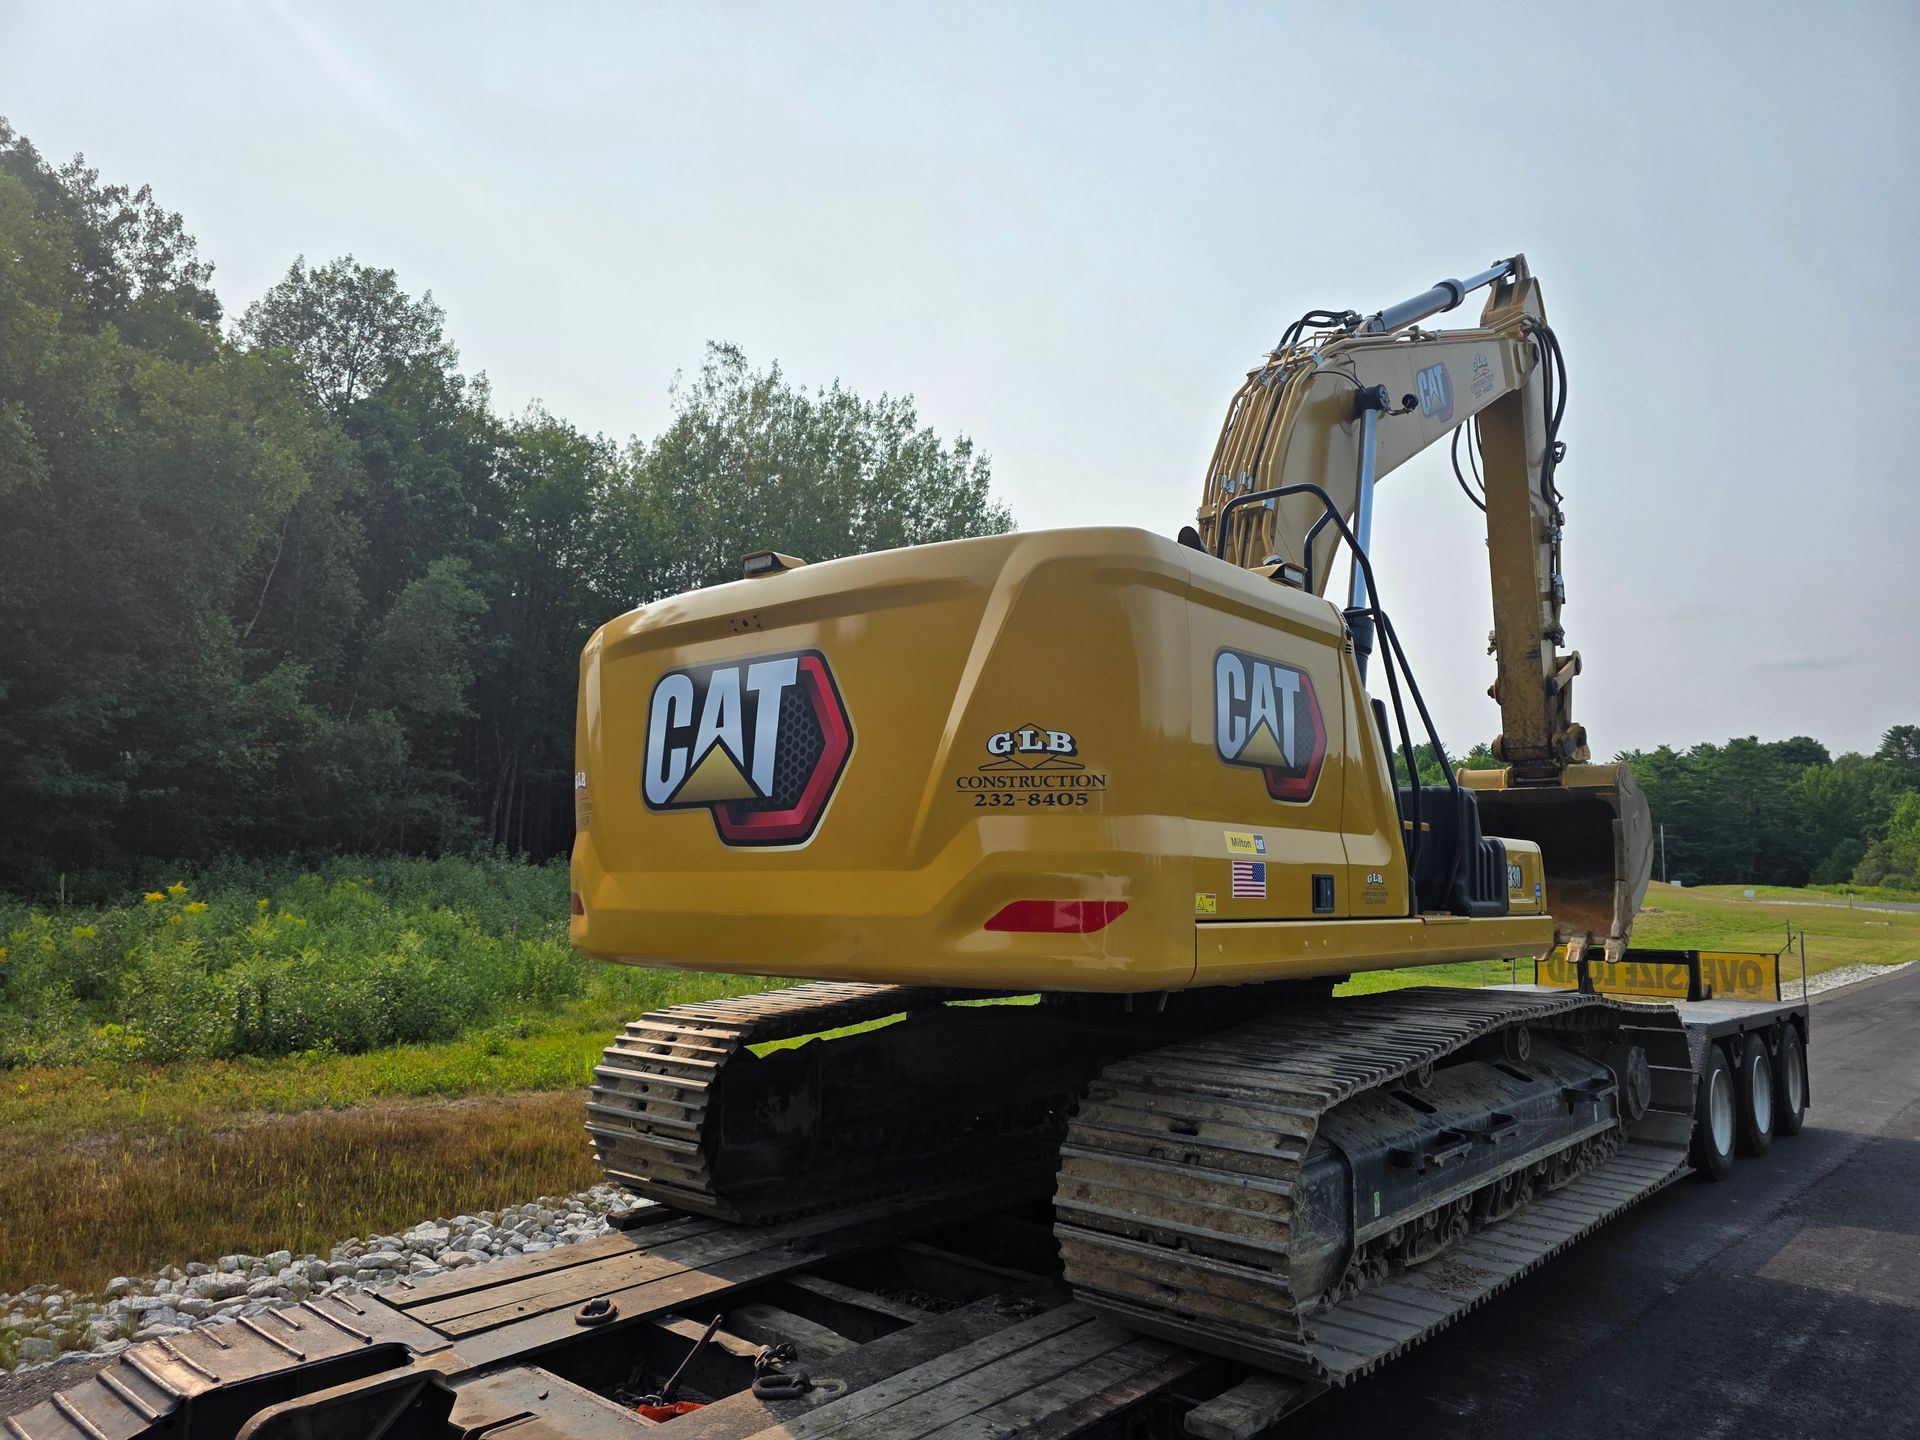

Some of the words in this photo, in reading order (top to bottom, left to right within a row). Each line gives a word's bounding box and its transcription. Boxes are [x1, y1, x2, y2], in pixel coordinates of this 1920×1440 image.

[1417, 364, 1447, 416] CAT
[1216, 652, 1300, 768] CAT
[645, 657, 798, 804] CAT
[987, 729, 1078, 757] GLB
[956, 774, 1107, 789] CONSTRUCTION
[974, 792, 1089, 807] 232-8405
[1231, 837, 1252, 849] Milton
[1367, 873, 1384, 884] GLB
